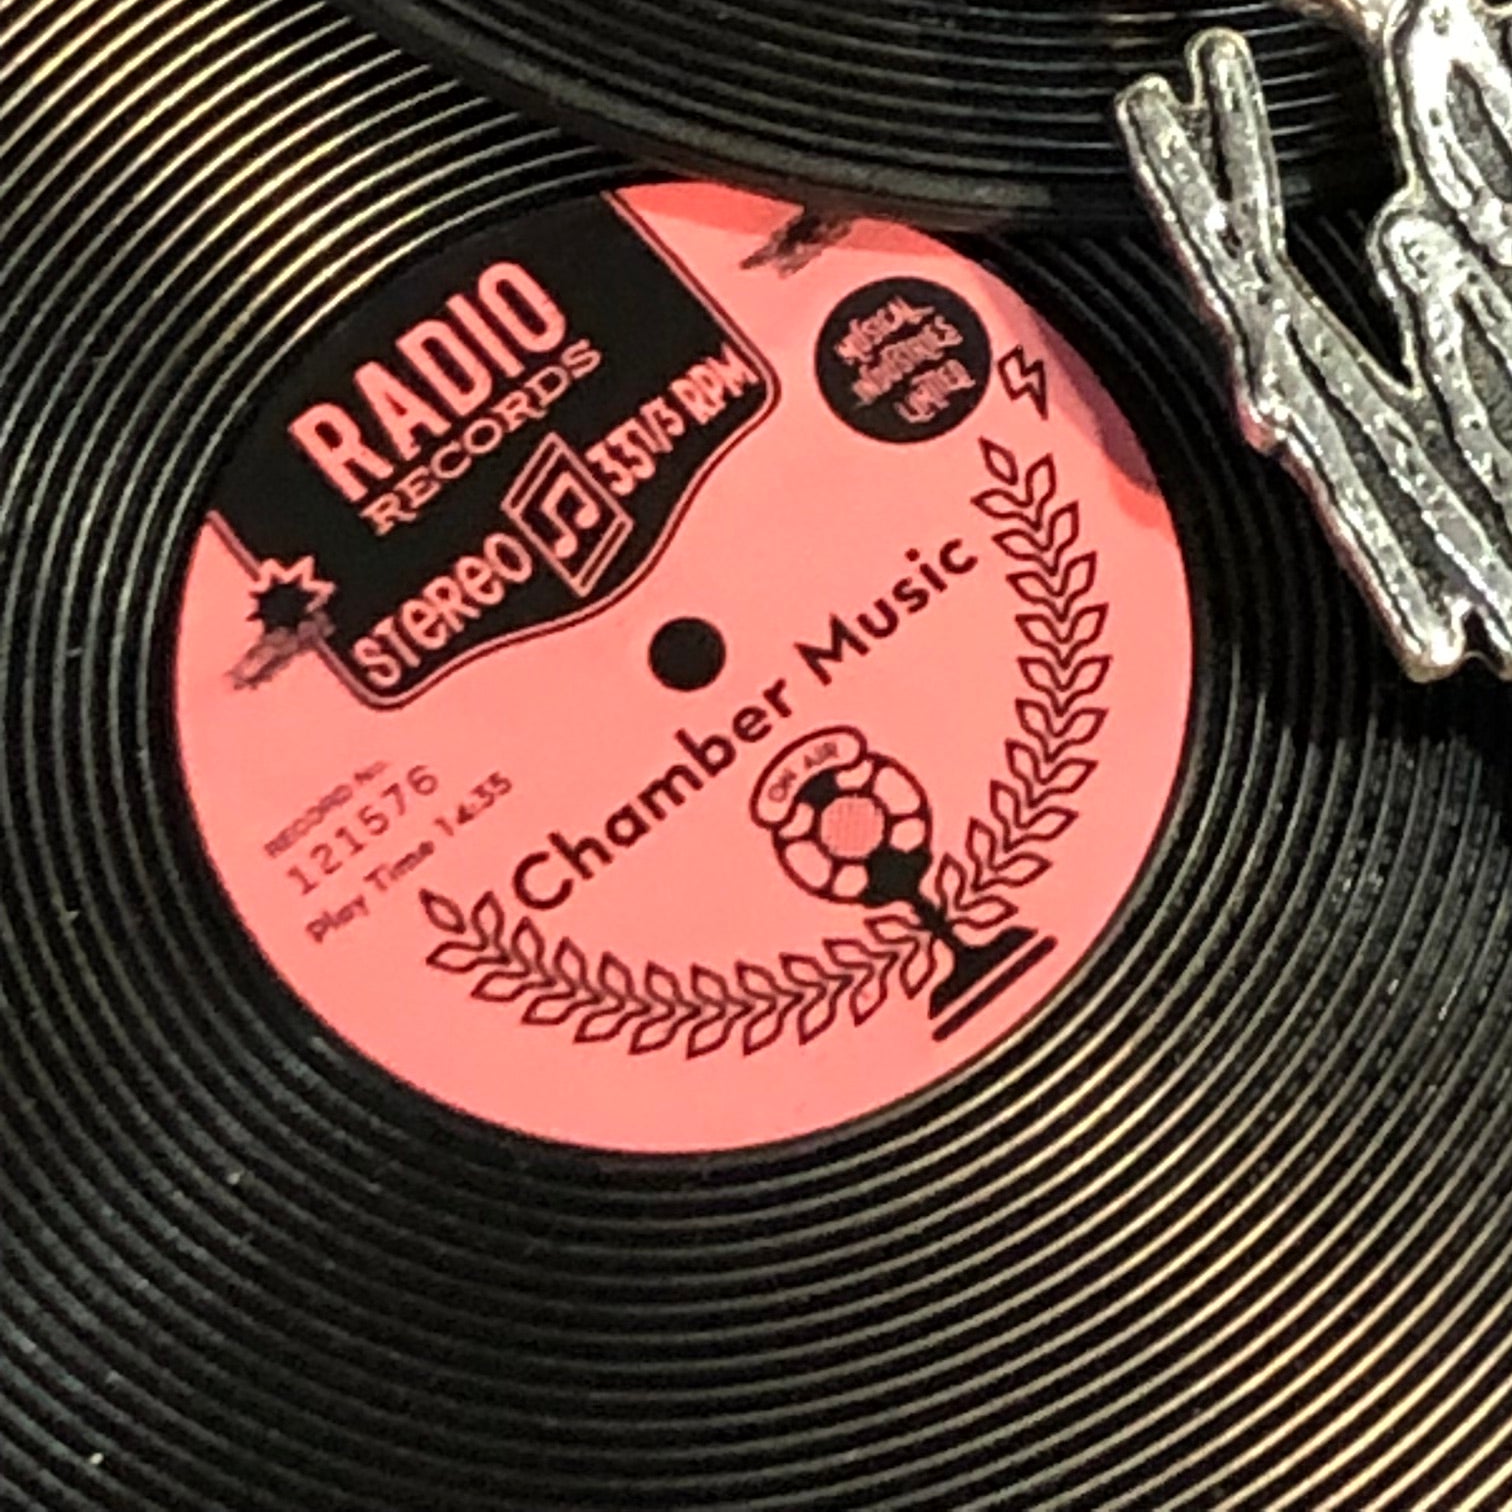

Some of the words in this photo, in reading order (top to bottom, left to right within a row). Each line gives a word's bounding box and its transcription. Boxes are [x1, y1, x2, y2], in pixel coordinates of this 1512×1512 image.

[288, 262, 566, 502] RADIO
[361, 337, 602, 537] RECORDS
[669, 342, 760, 425] RPM
[512, 678, 793, 911] Chamber
[794, 538, 979, 687] Music
[286, 764, 440, 897] 121576
[305, 894, 370, 944] Play
[363, 840, 435, 892] Time
